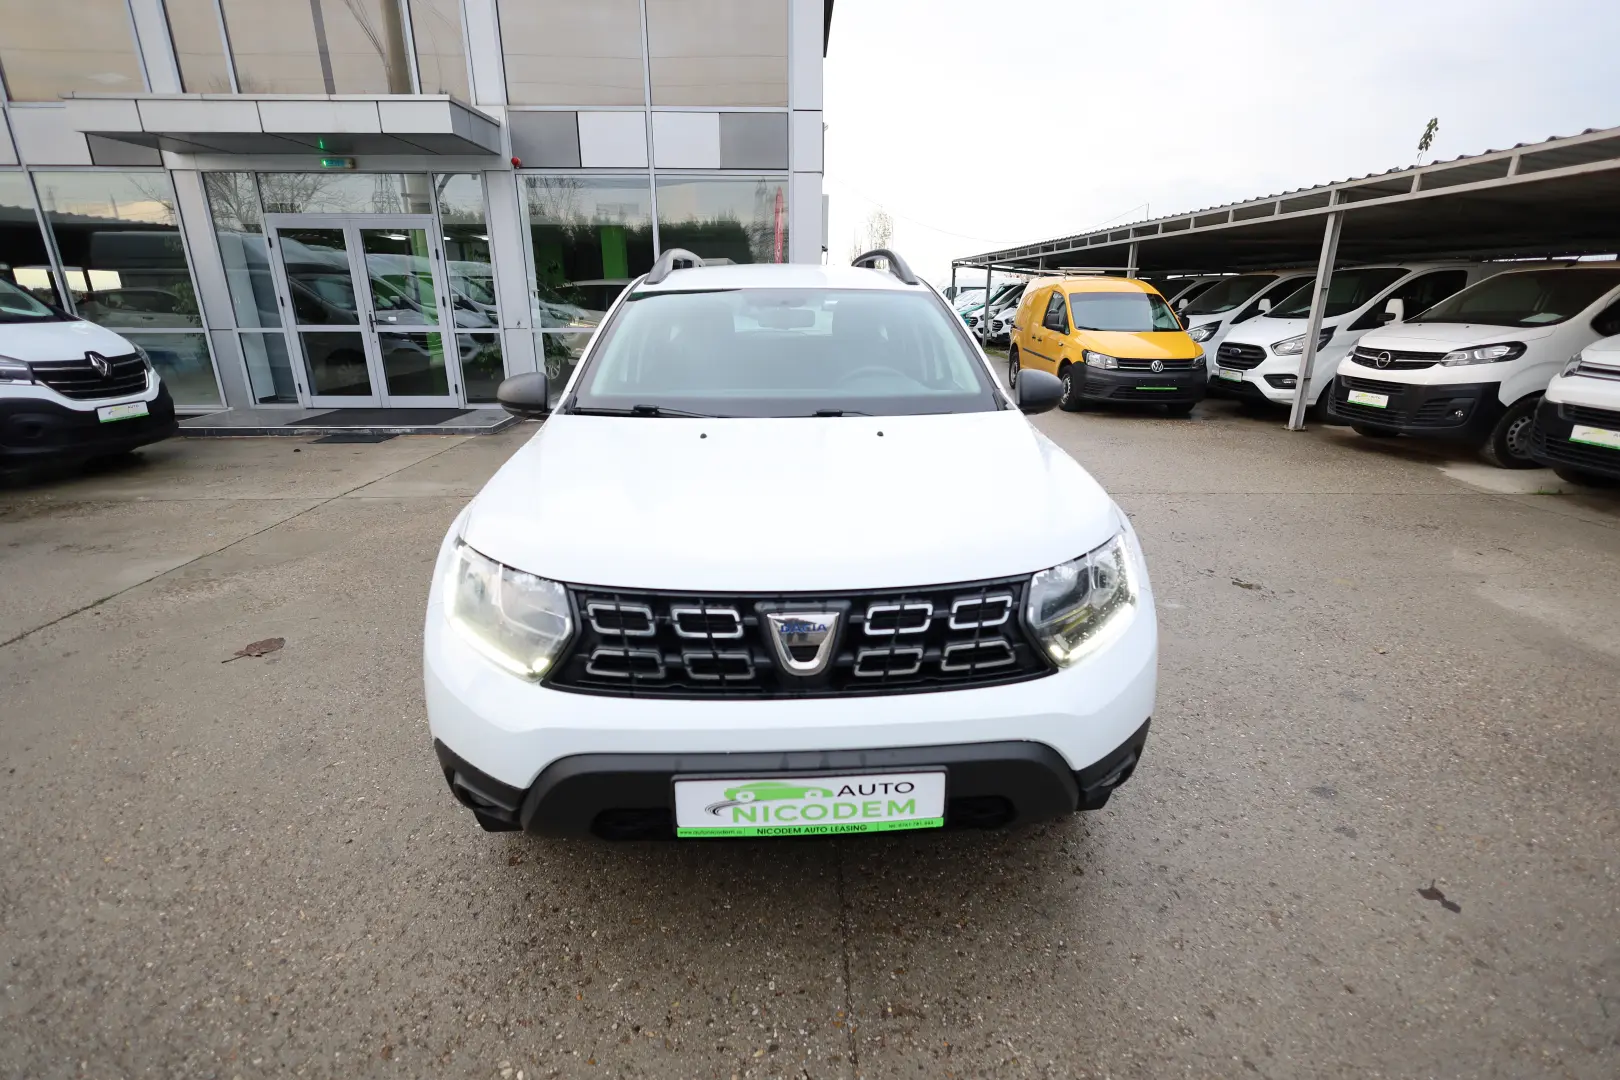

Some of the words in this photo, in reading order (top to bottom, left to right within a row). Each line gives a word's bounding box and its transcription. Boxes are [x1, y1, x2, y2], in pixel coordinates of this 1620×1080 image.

[780, 623, 827, 633] DACIA
[837, 781, 915, 797] AUTO
[732, 798, 916, 823] NICODEM
[756, 827, 801, 835] NICODEM
[830, 824, 868, 833] LEASING
